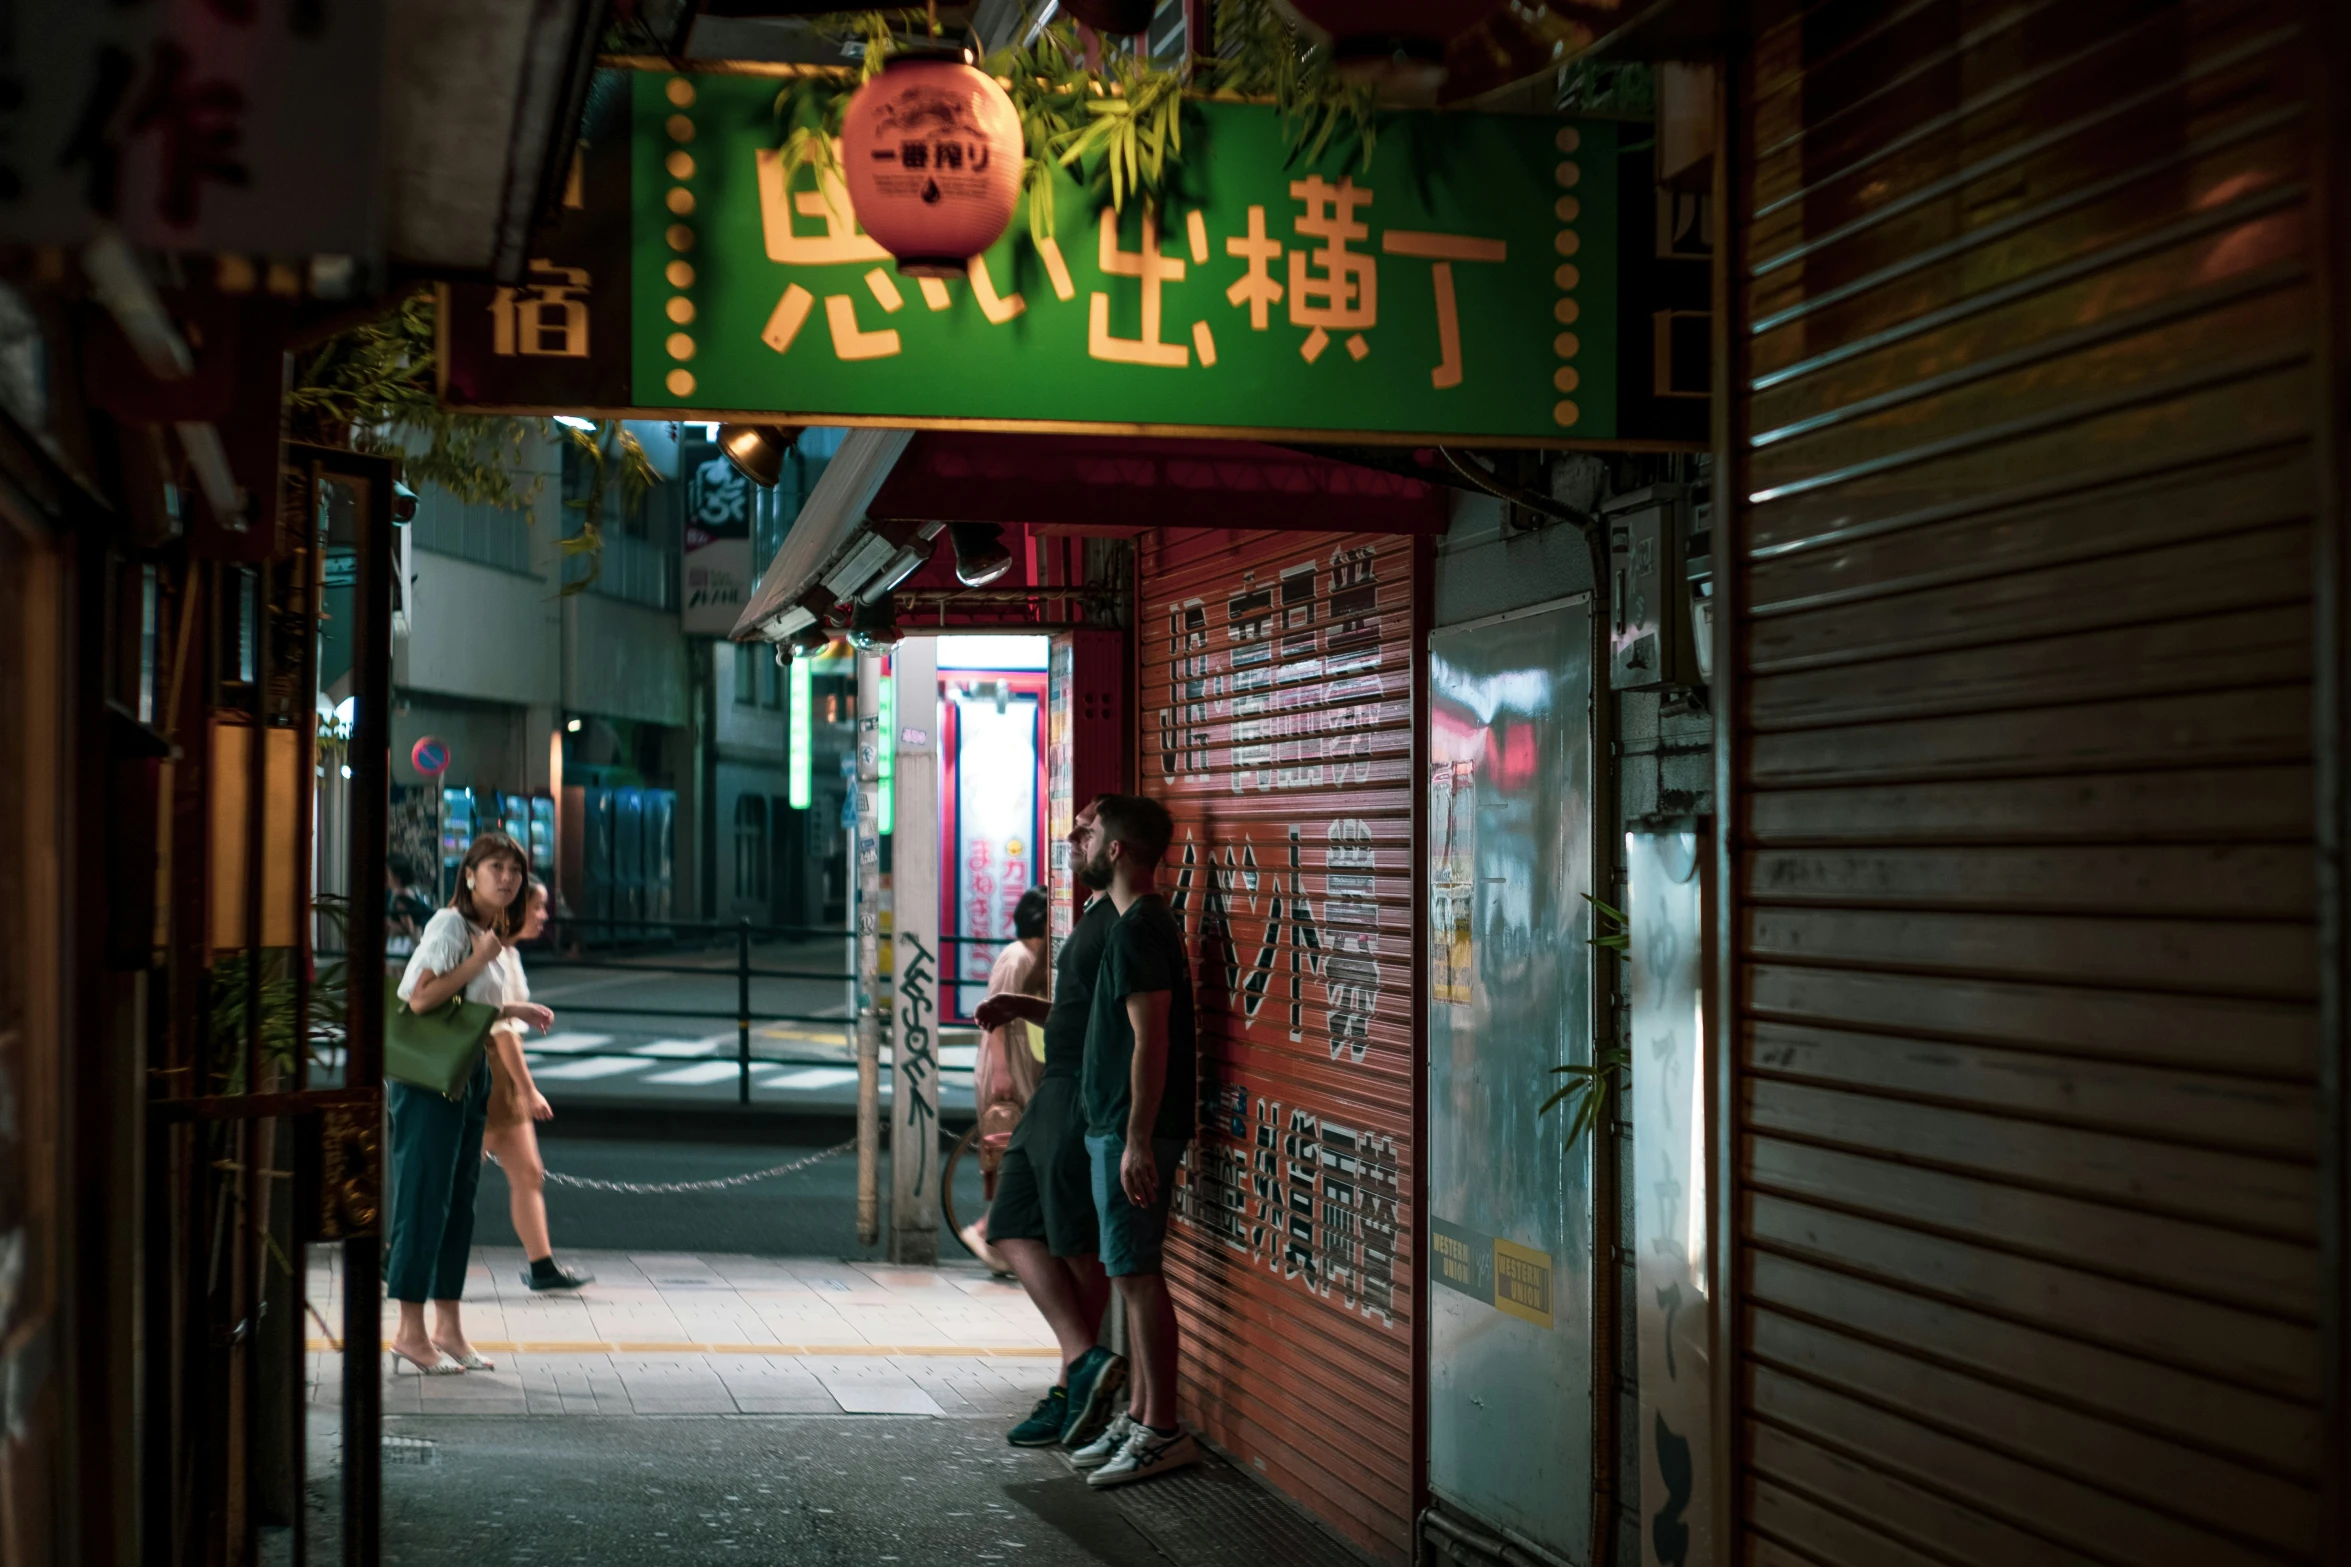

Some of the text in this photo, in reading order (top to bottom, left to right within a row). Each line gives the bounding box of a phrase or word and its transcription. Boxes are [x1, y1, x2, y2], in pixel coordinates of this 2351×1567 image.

[1252, 1097, 1400, 1329] 外貨両替
[1433, 1232, 1468, 1264] WESTERN
[1444, 1257, 1468, 1284] UNION
[1498, 1254, 1540, 1287] WESTERN
[1511, 1281, 1540, 1308] UNION
